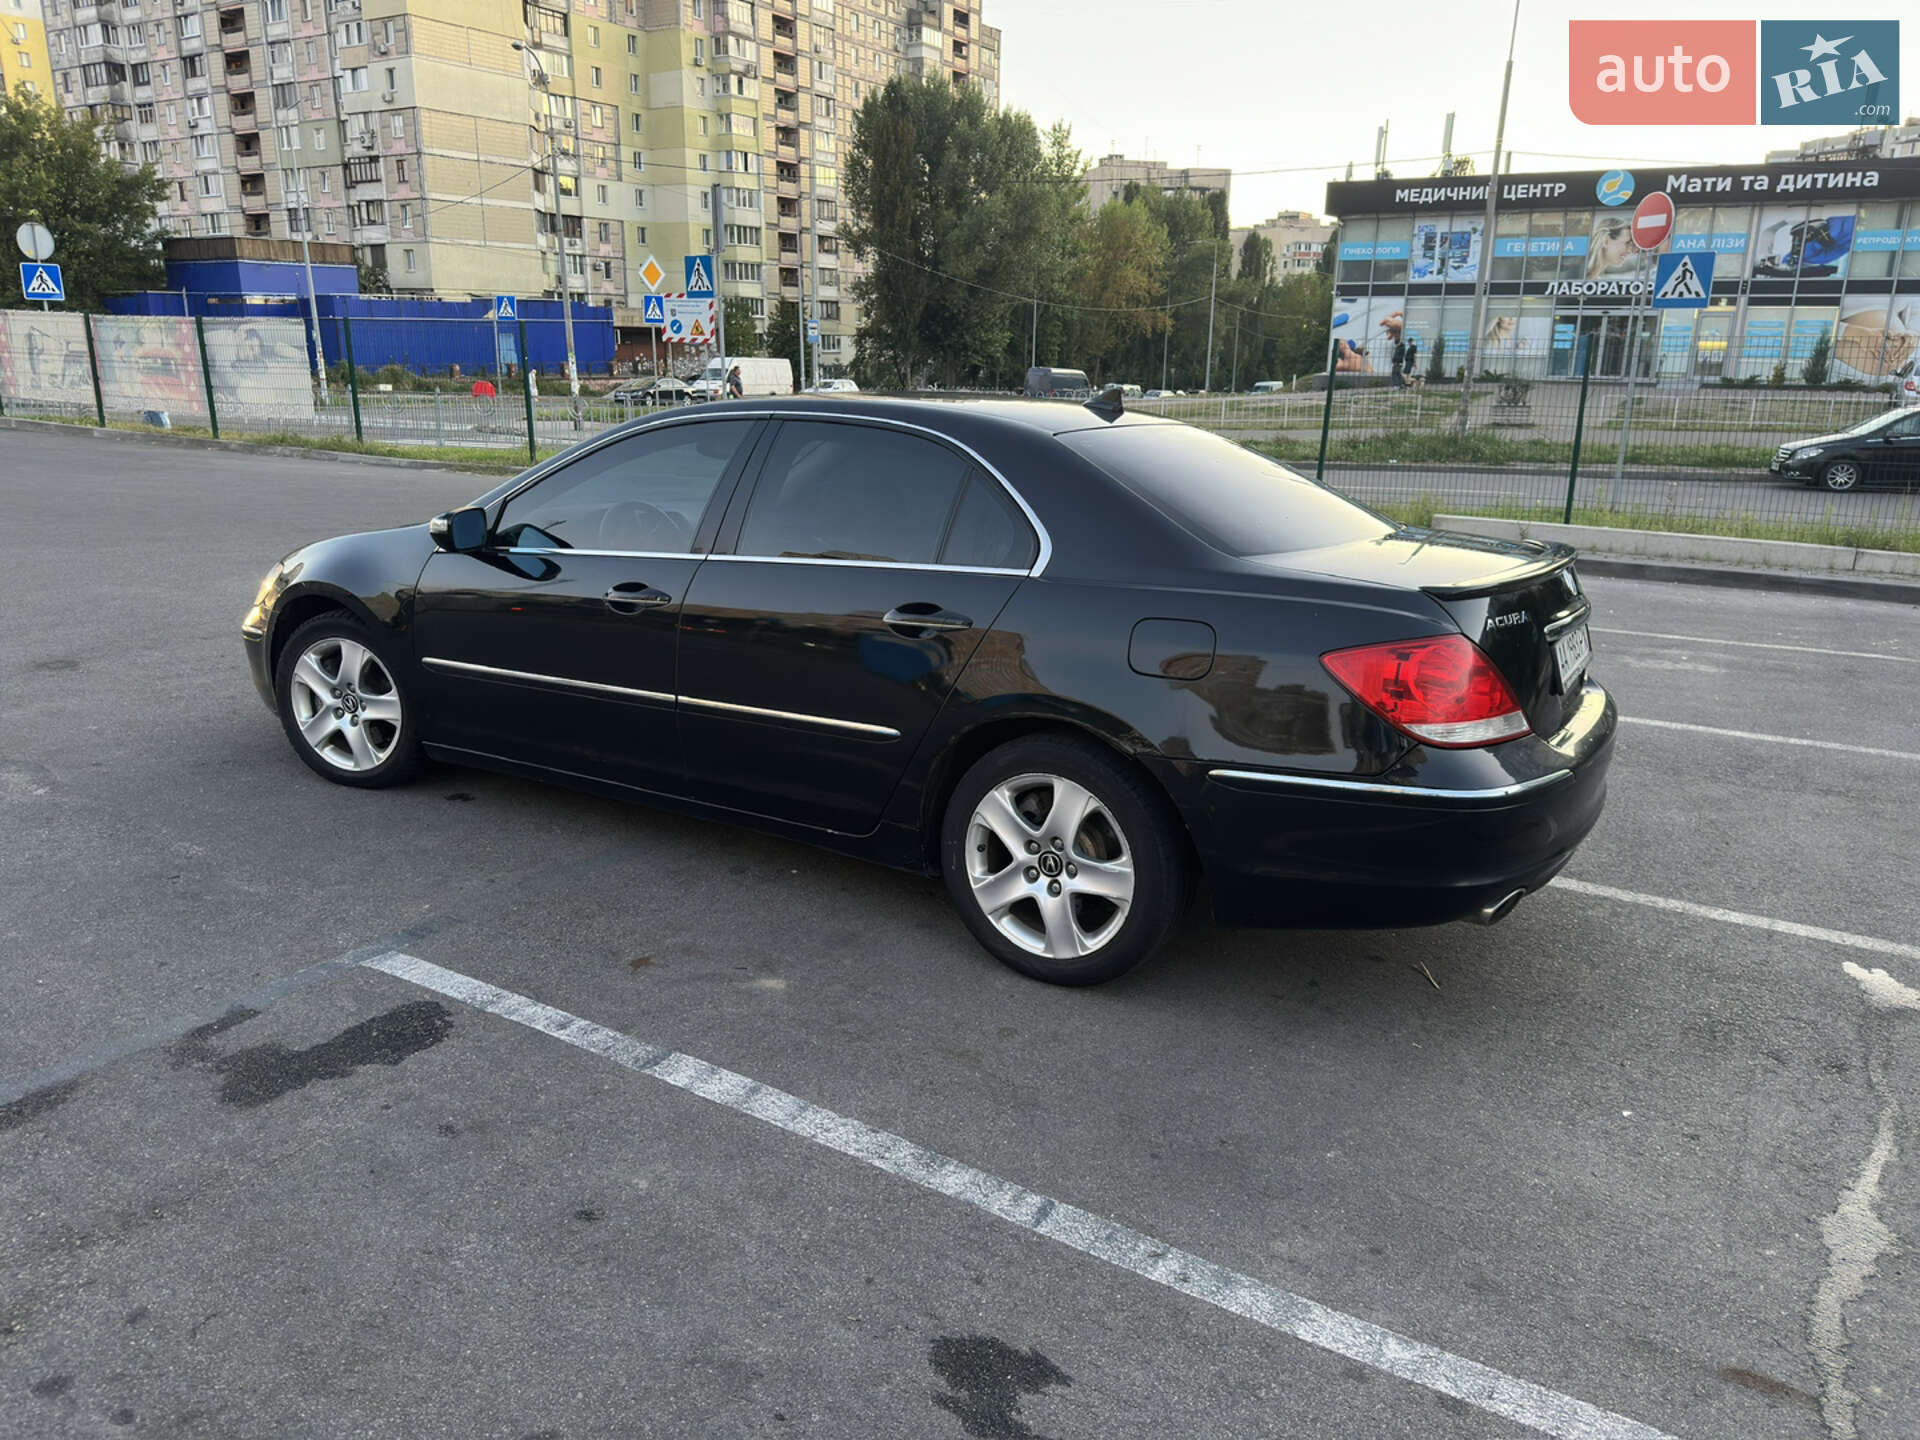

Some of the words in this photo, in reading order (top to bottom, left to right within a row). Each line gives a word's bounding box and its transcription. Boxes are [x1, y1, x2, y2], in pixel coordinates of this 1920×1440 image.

[1503, 183, 1567, 201] ЦЕНТР
[1666, 173, 1732, 193] Мати
[1740, 175, 1769, 191] та
[1776, 170, 1880, 193] дитина
[1486, 610, 1527, 631] ACURA
